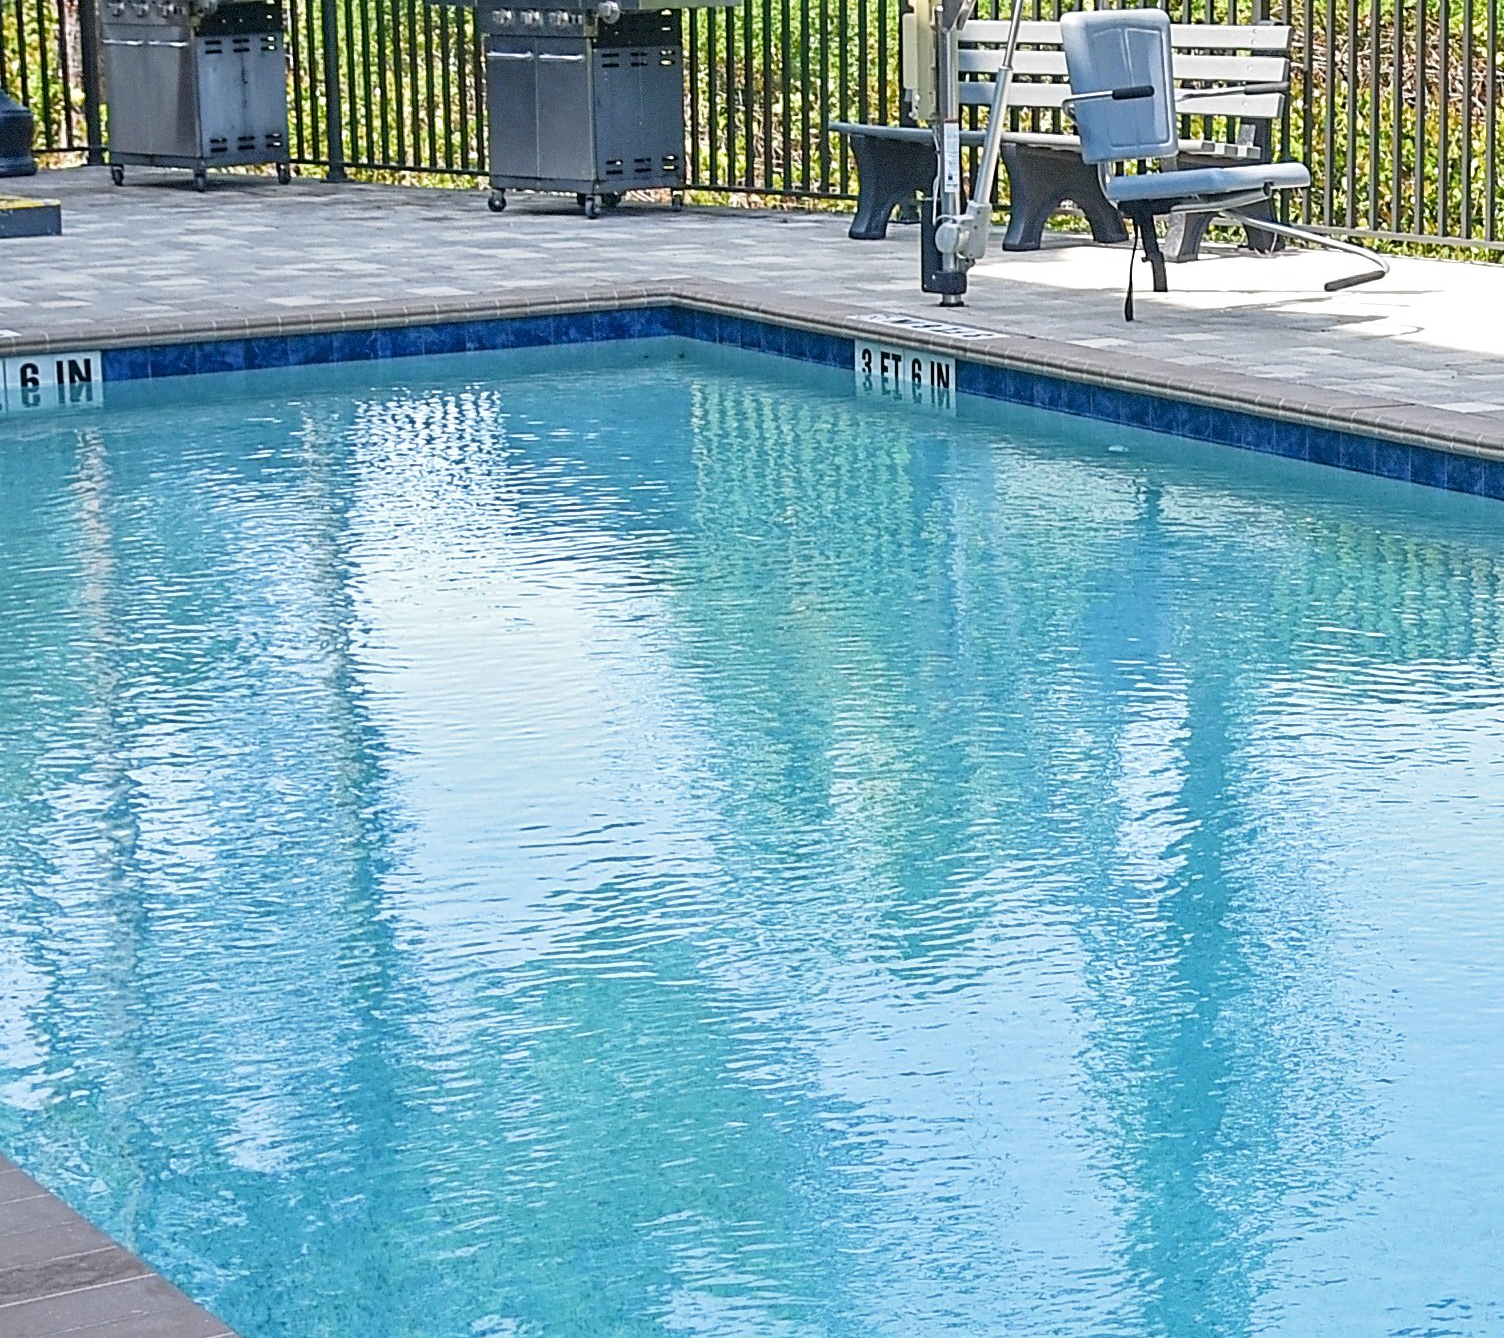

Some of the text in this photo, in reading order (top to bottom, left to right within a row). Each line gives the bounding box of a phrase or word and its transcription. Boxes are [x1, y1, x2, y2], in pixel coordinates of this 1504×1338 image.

[19, 362, 40, 388] 6
[55, 358, 92, 385] IN
[861, 348, 950, 389] 3 FT 6 IN
